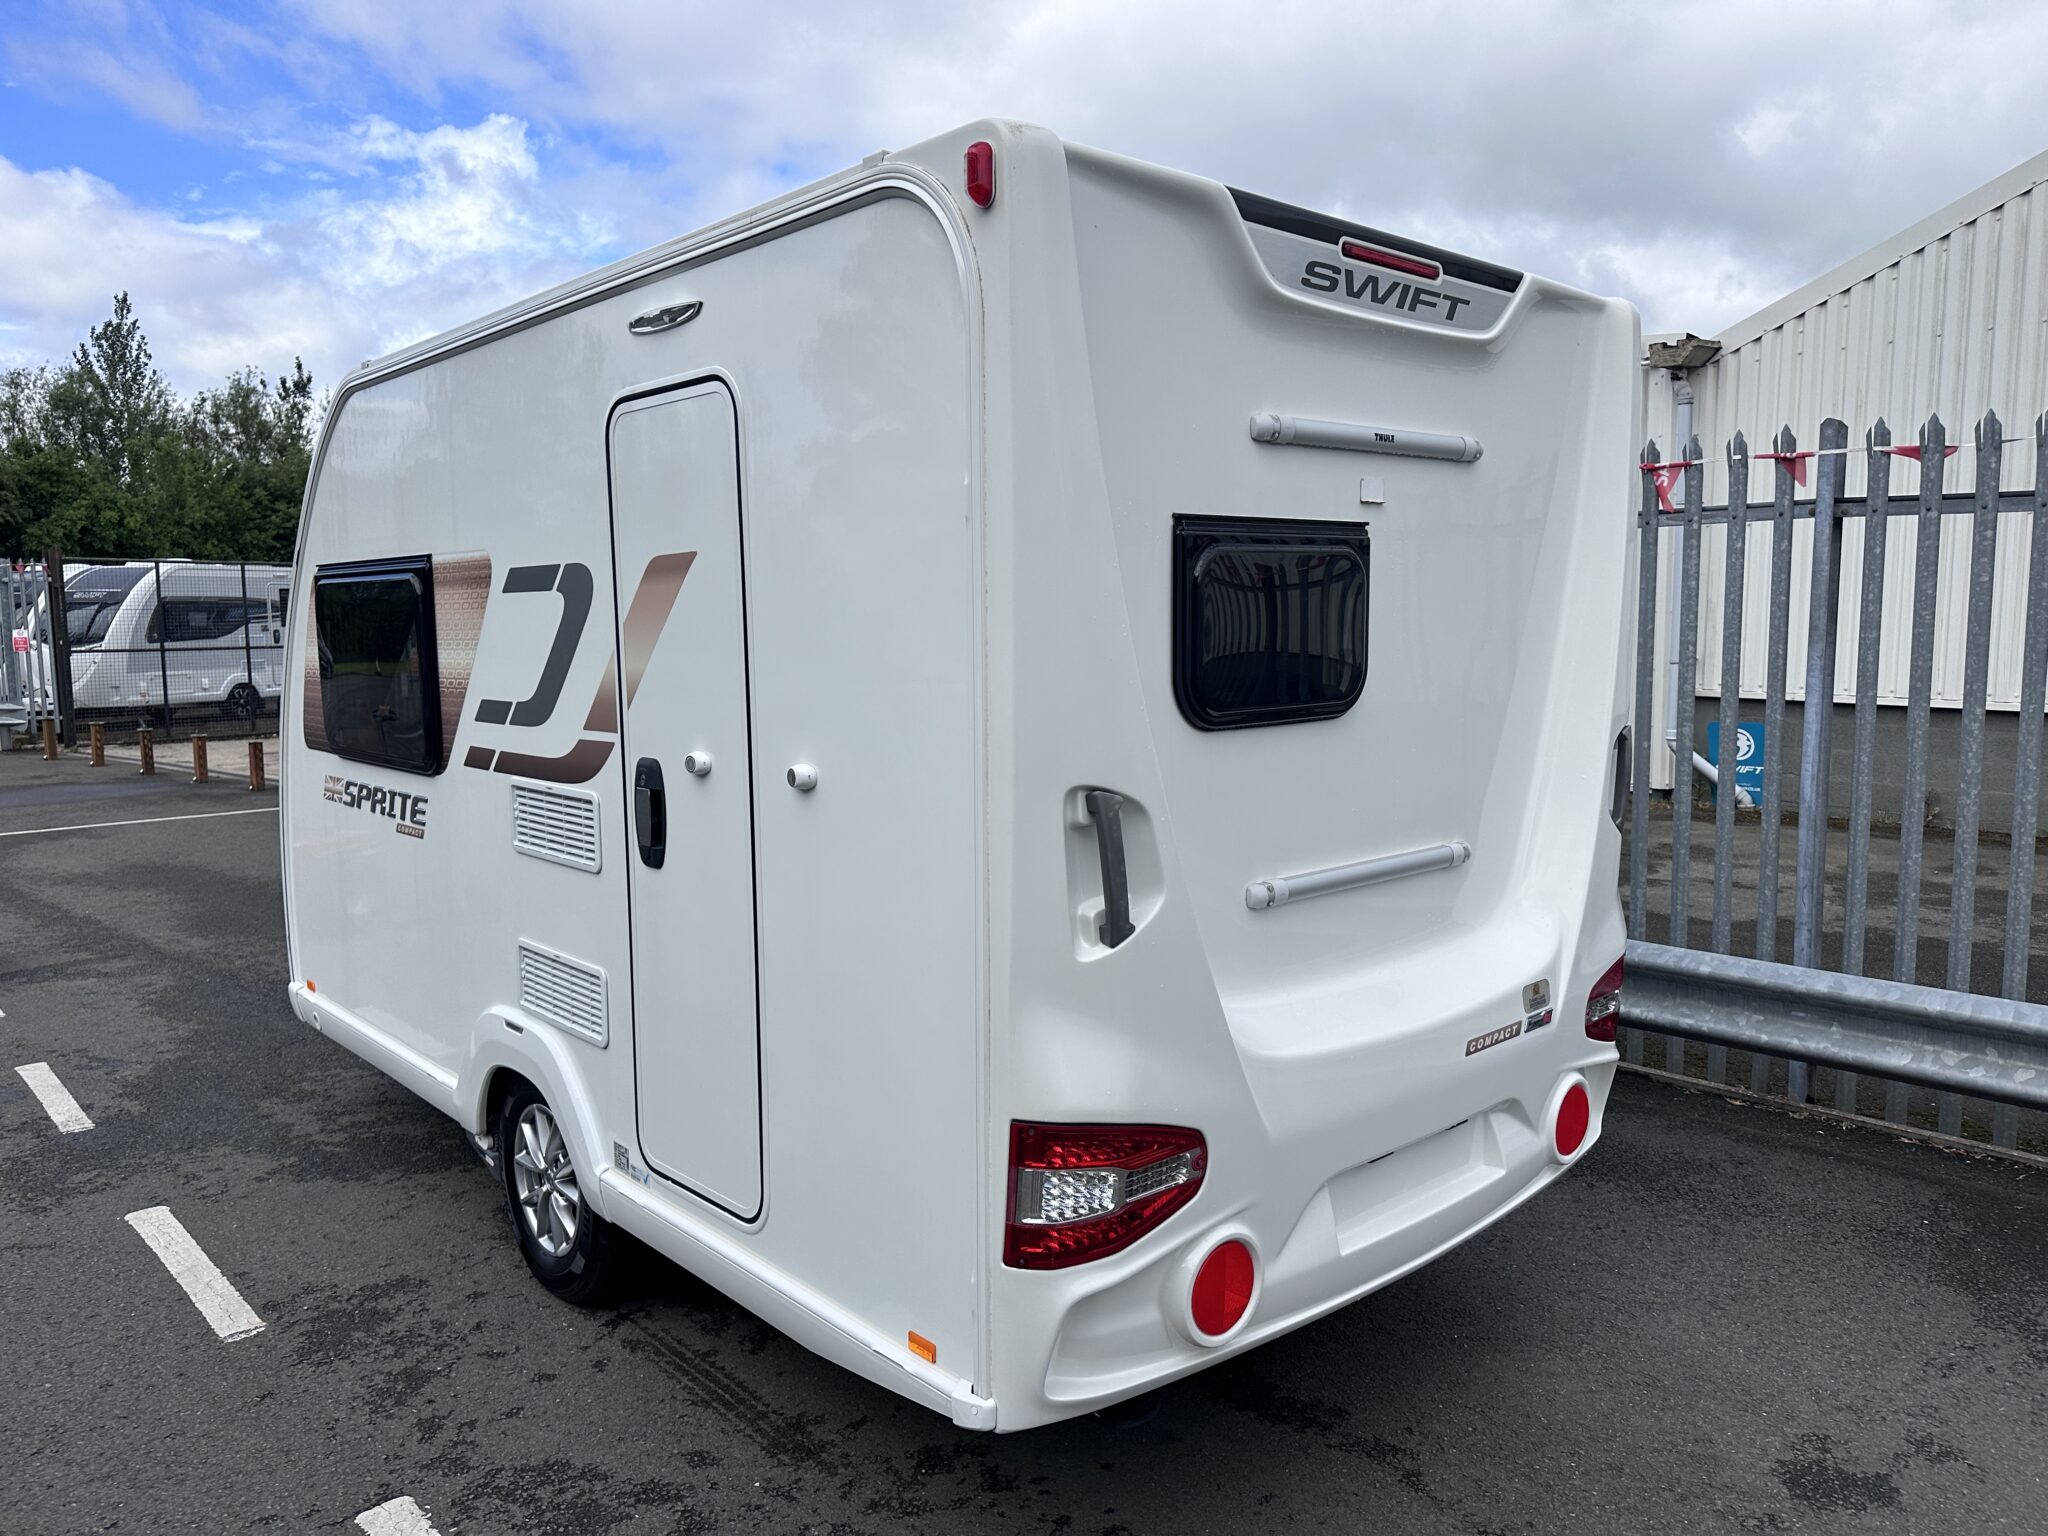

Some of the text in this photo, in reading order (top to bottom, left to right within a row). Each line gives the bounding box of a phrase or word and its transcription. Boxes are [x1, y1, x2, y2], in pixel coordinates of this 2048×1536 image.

[1300, 260, 1471, 321] SWIFT
[1374, 432, 1395, 443] THULE
[343, 780, 429, 827] SPRITE
[396, 824, 424, 838] COMPACT
[1469, 1024, 1519, 1052] COMPACT
